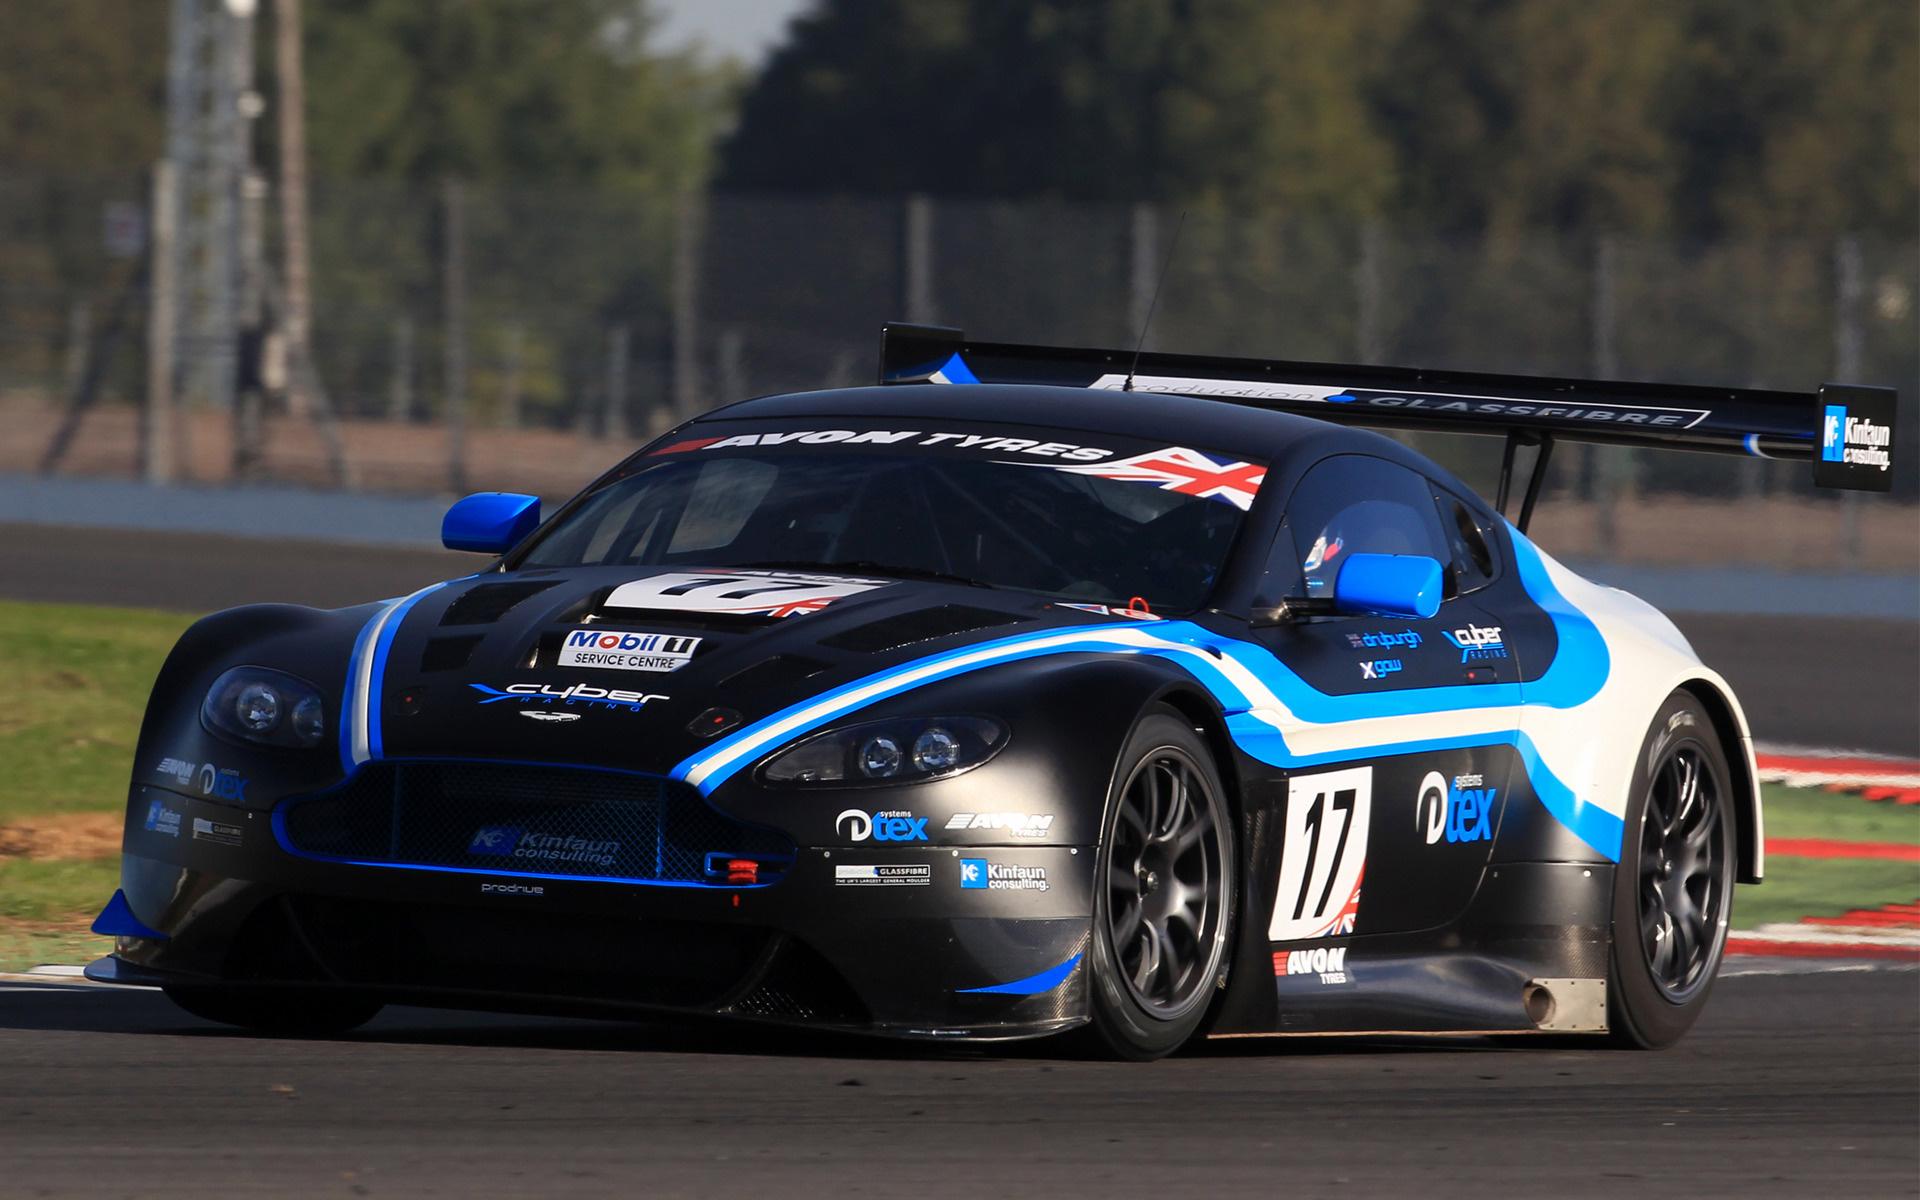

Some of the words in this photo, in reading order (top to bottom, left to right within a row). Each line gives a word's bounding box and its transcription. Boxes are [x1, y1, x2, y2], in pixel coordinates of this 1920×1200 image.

[1368, 396, 1684, 426] GLASSFIBRE
[1844, 416, 1890, 446] Kinfaun
[702, 430, 921, 450] AVON
[919, 432, 1113, 461] TYRES
[569, 631, 661, 652] Mobil
[1455, 624, 1502, 649] cyber
[574, 652, 624, 666] SERVICE
[629, 654, 675, 669] CENTRE
[506, 683, 670, 705] cyber
[520, 697, 643, 713] RACING
[879, 810, 912, 819] systems
[968, 812, 1055, 830] AVON
[519, 832, 622, 854] Kinfaun
[514, 848, 617, 866] consulting.
[1291, 788, 1357, 921] 17
[879, 867, 928, 876] GLASSFIBRE
[988, 864, 1046, 879] Kinfaun
[480, 883, 544, 894] prodrive
[988, 878, 1050, 892] consulting.
[1286, 947, 1347, 975] AVON
[1320, 973, 1347, 985] TYRES
